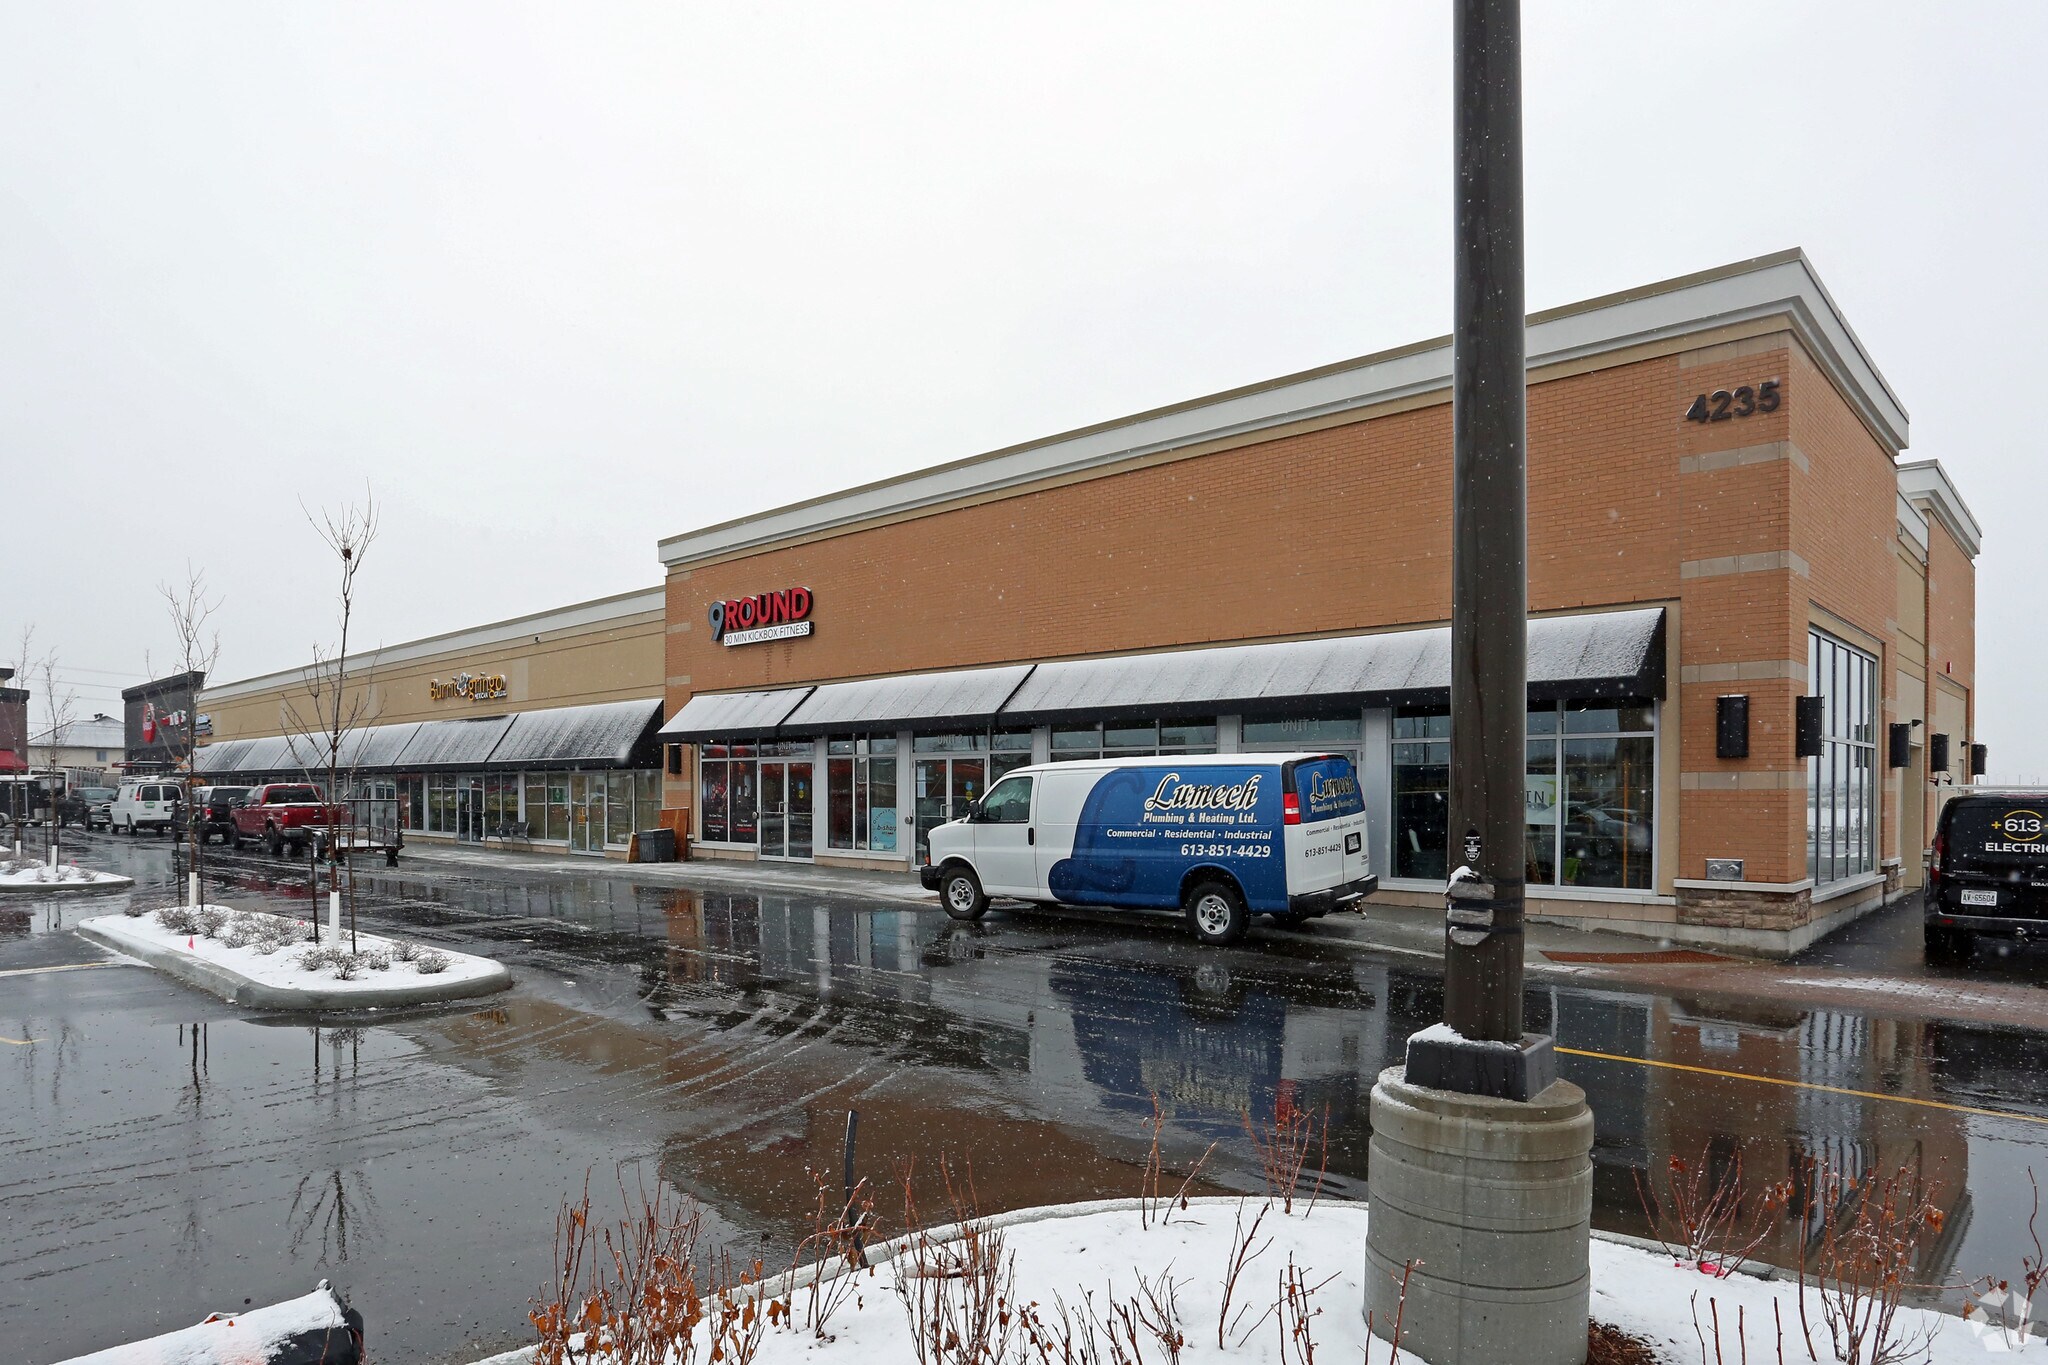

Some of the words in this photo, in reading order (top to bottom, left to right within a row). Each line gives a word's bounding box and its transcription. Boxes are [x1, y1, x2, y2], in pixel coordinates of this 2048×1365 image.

[1685, 380, 1780, 423] 4235
[708, 587, 813, 640] 9ROUND
[724, 635, 733, 645] 30
[733, 633, 747, 643] MIN
[748, 628, 778, 641] KICKBOX
[779, 623, 809, 637] FITNESS
[1281, 719, 1309, 731] UNIT
[777, 741, 791, 750] UNIT
[938, 734, 956, 744] UNIT
[1144, 772, 1263, 812] Lumech
[1143, 812, 1185, 824] Plumbing
[1188, 812, 1195, 823] &
[1198, 812, 1235, 825] Heating
[1238, 812, 1257, 823] Ltd.
[1306, 826, 1330, 836] Commercial
[2004, 819, 2041, 832] 613
[1106, 828, 1156, 838] Commercial
[1164, 829, 1215, 839] Residential
[1224, 830, 1273, 840] Industrial
[1181, 844, 1271, 858] 613-851-4429
[1304, 843, 1341, 858] 613-851-4429
